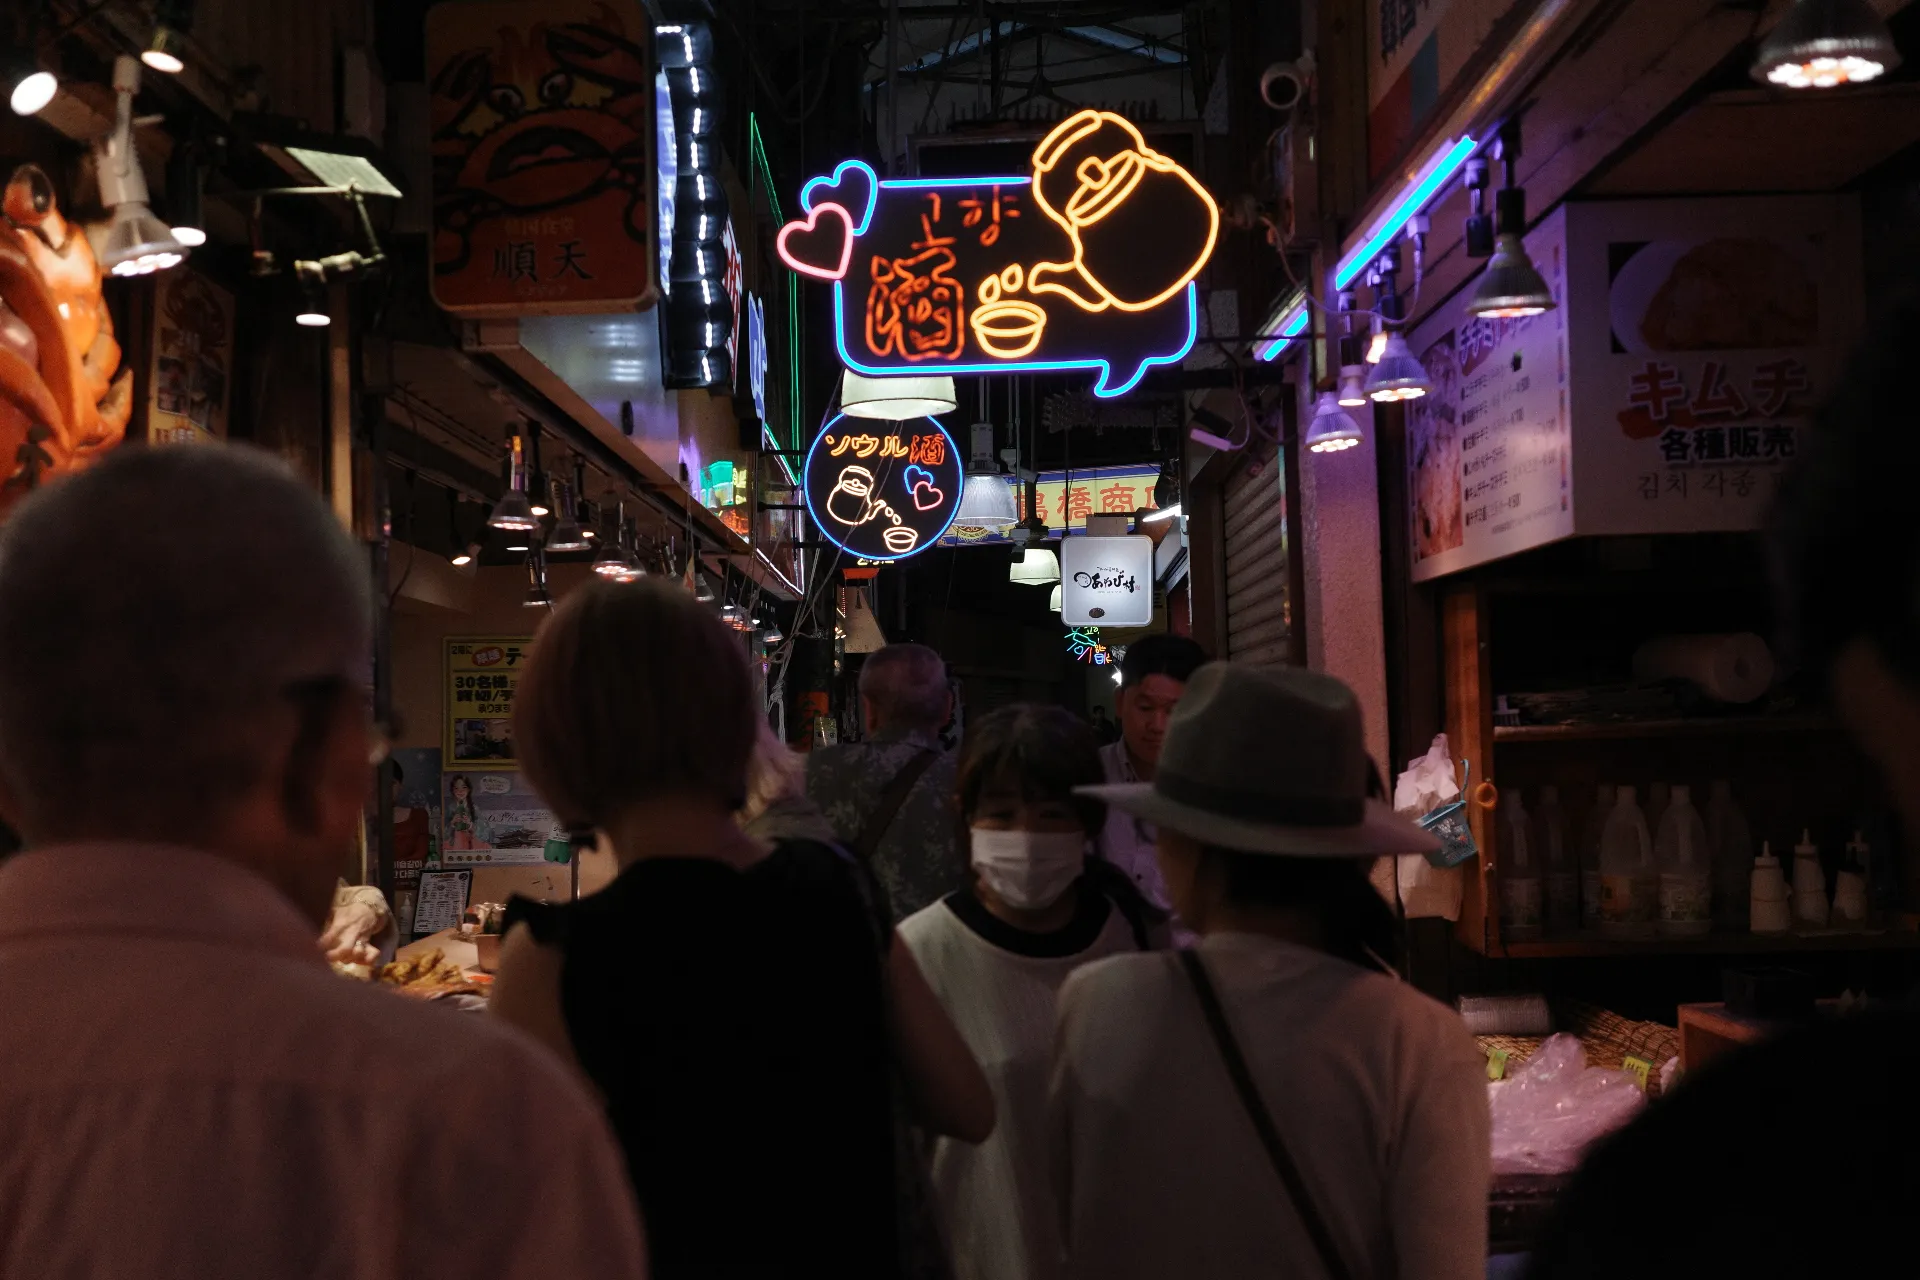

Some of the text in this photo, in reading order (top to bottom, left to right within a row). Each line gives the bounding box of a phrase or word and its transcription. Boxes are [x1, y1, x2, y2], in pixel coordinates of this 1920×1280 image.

[911, 185, 1020, 248] 고향
[491, 240, 595, 283] 順天
[1630, 357, 1807, 419] キムチ
[825, 433, 945, 466] ソウル酒
[1661, 426, 1795, 461] 各種販売
[1637, 471, 1688, 499] 김치
[1702, 470, 1757, 498] 각종
